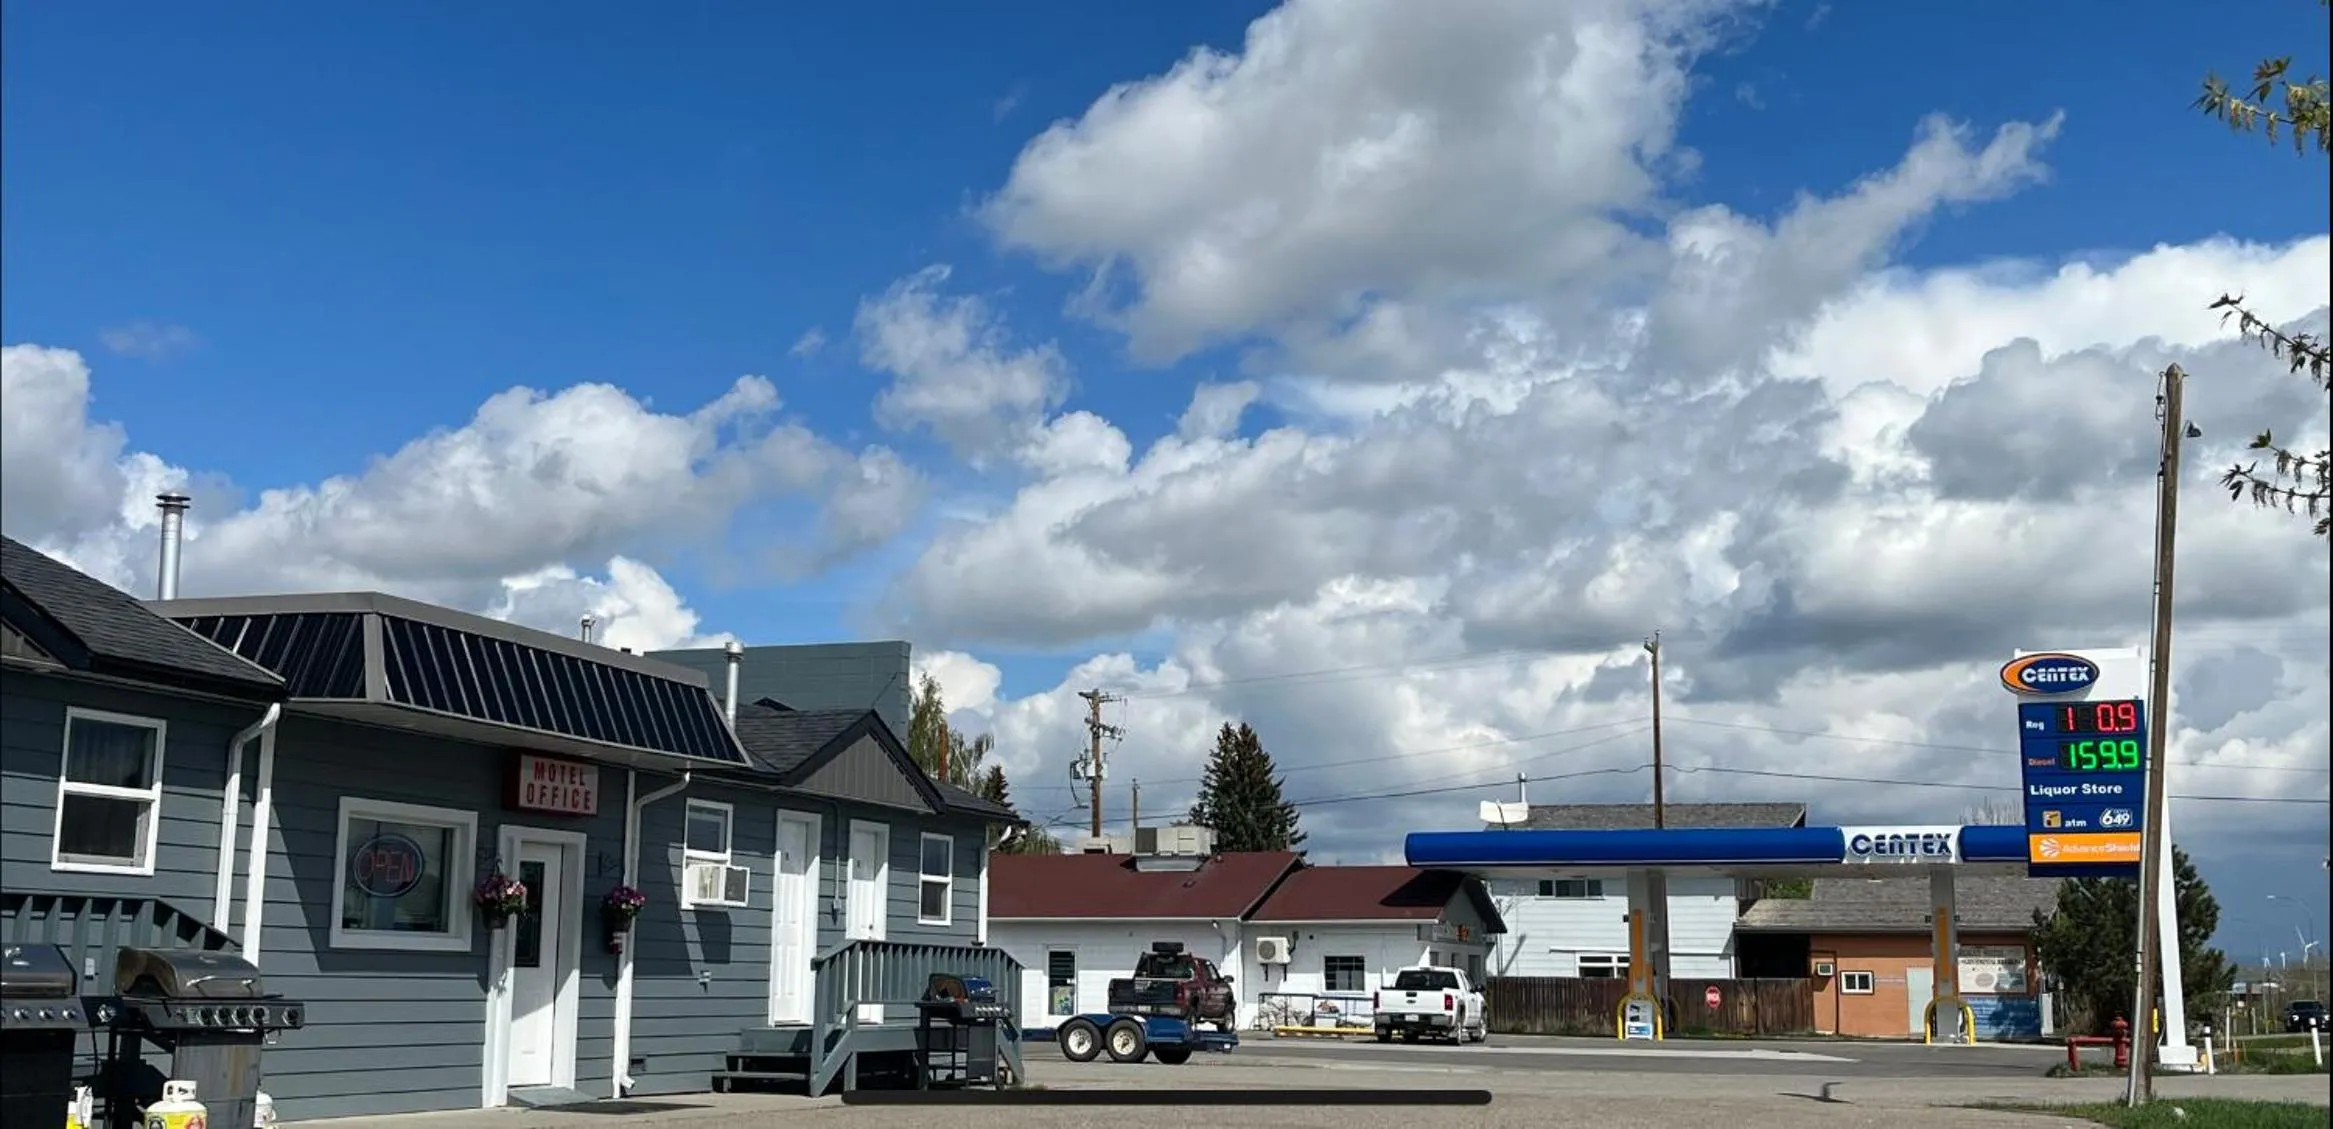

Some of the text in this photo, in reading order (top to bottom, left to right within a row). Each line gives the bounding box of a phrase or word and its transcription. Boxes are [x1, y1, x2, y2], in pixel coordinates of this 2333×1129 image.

[2021, 666, 2090, 684] CENTEX
[2025, 720, 2045, 731] Reg
[2069, 740, 2139, 769] 159.9
[534, 761, 586, 786] MOTEL
[526, 783, 592, 811] OFFICE
[2030, 783, 2123, 798] Liquor Store
[2064, 818, 2088, 828] atm
[1850, 833, 1953, 856] CENTEX
[357, 846, 416, 884] OPEN
